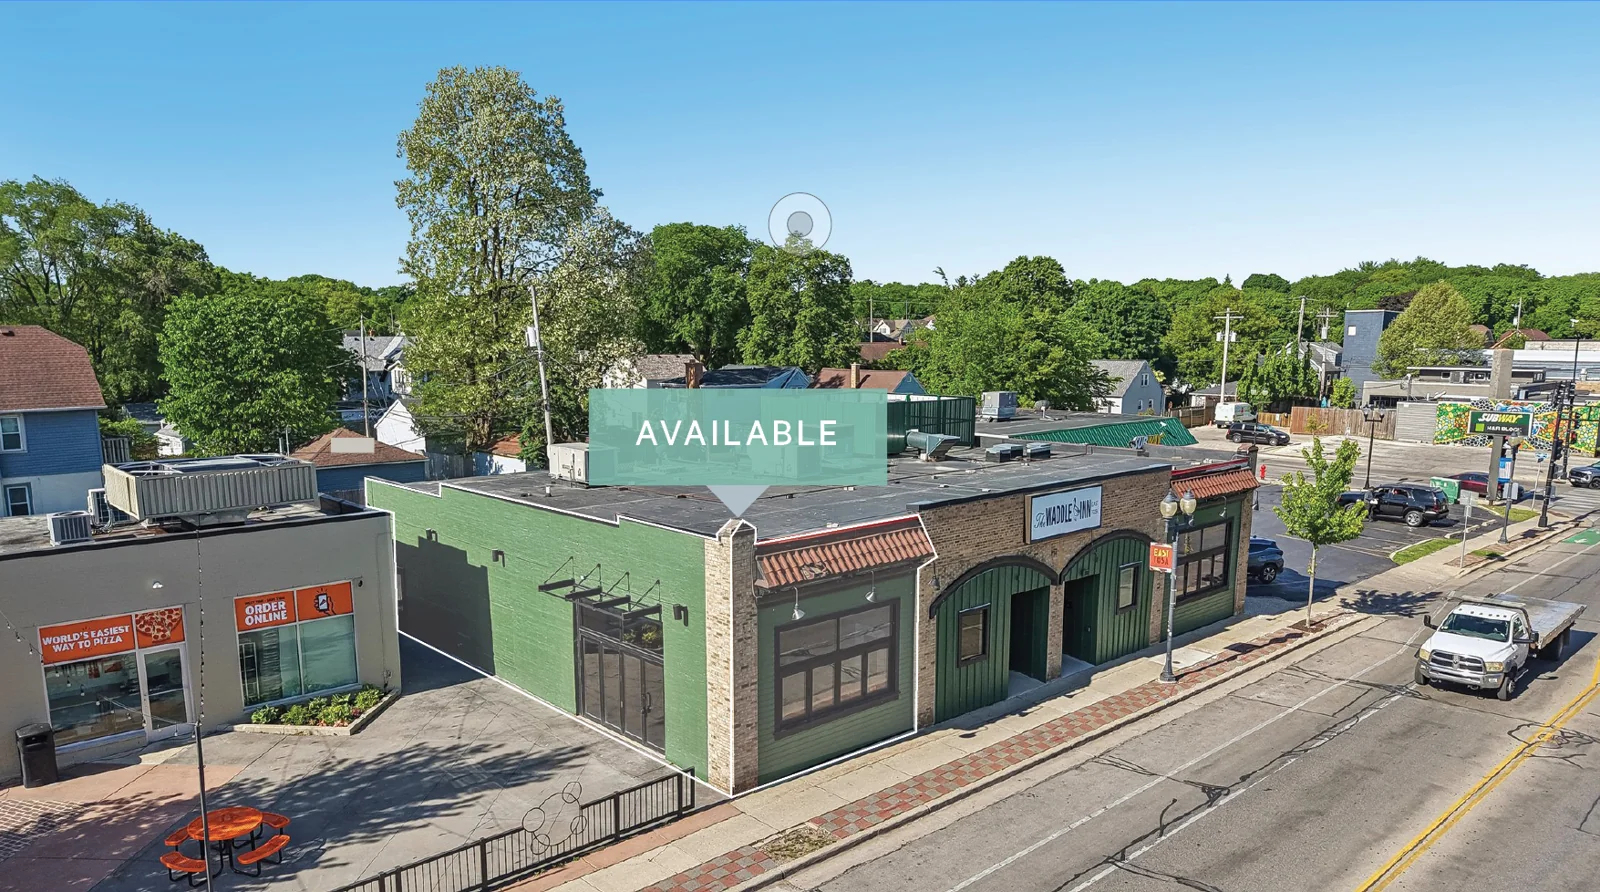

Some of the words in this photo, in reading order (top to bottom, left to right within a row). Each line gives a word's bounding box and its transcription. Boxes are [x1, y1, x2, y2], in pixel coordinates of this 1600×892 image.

[1478, 413, 1523, 423] SUBWAY
[1034, 512, 1045, 528] The
[1045, 503, 1072, 526] WADDLE
[1080, 499, 1091, 519] INN
[1154, 548, 1169, 557] EAST
[1153, 556, 1169, 565] TOSA
[245, 600, 286, 615] ORDER
[245, 610, 287, 626] ONLINE
[42, 631, 88, 646] WORLD'S
[90, 625, 130, 638] EASIEST
[52, 643, 75, 653] WAY
[78, 640, 91, 649] TO
[93, 635, 122, 646] PIZZA
